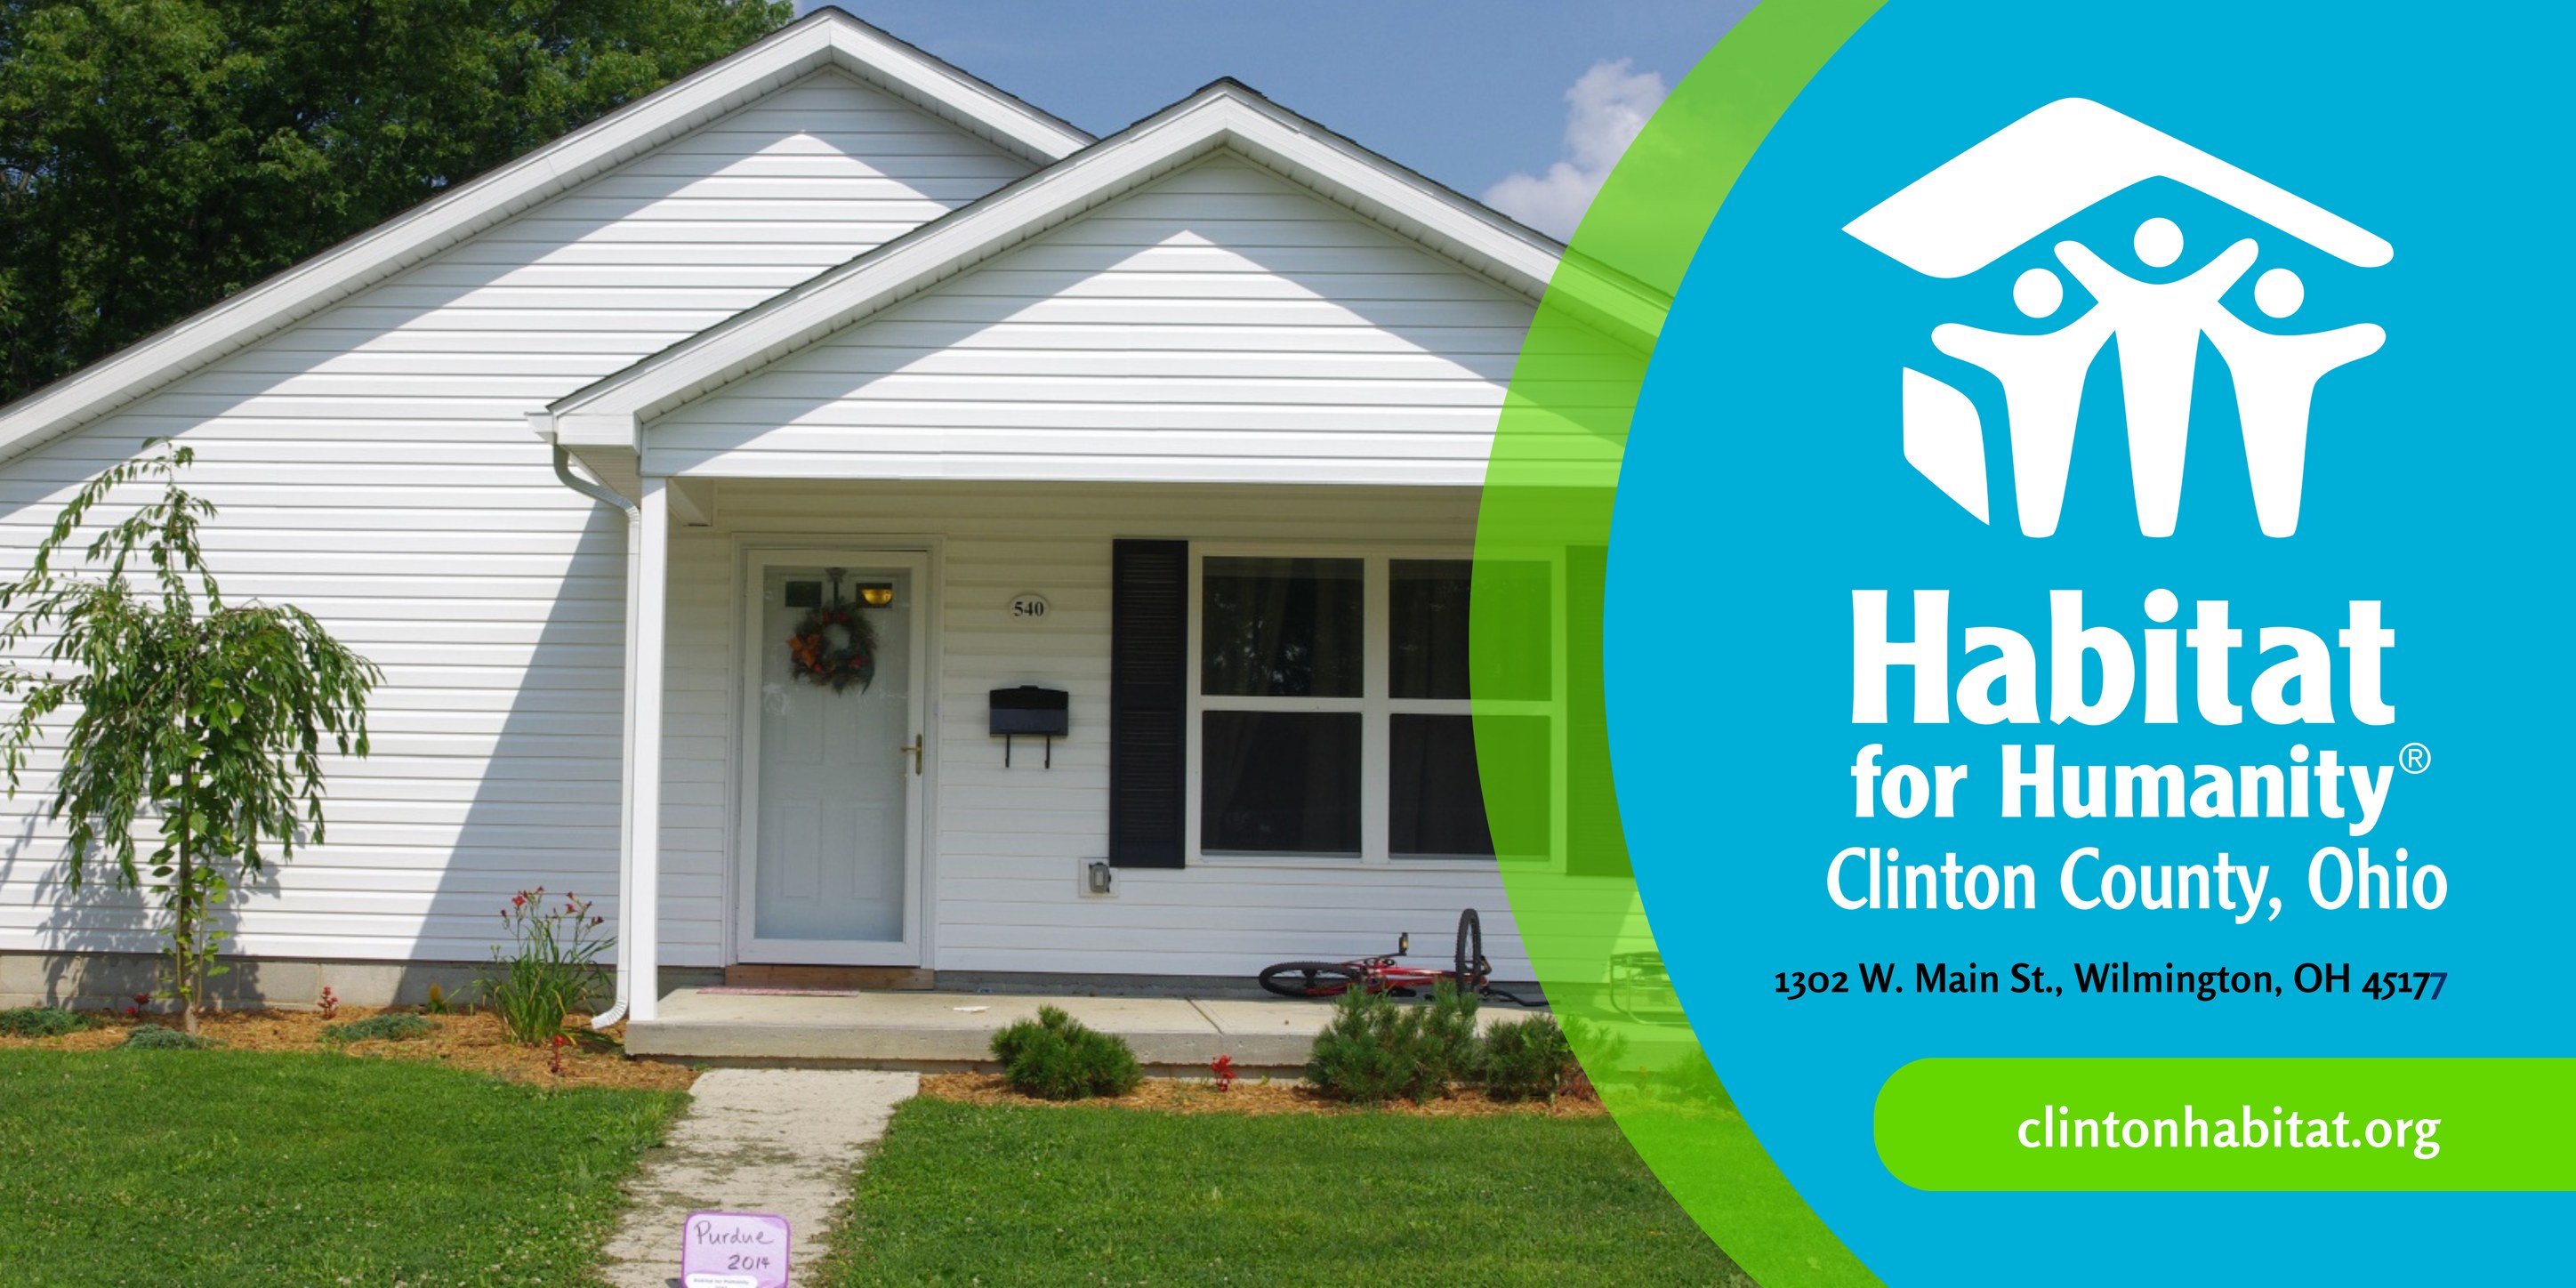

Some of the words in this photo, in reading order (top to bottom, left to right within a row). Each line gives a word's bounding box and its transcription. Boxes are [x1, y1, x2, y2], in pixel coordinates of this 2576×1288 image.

[1014, 600, 1044, 617] 540
[694, 1220, 774, 1245] Purdue
[728, 1254, 770, 1270] 2014
